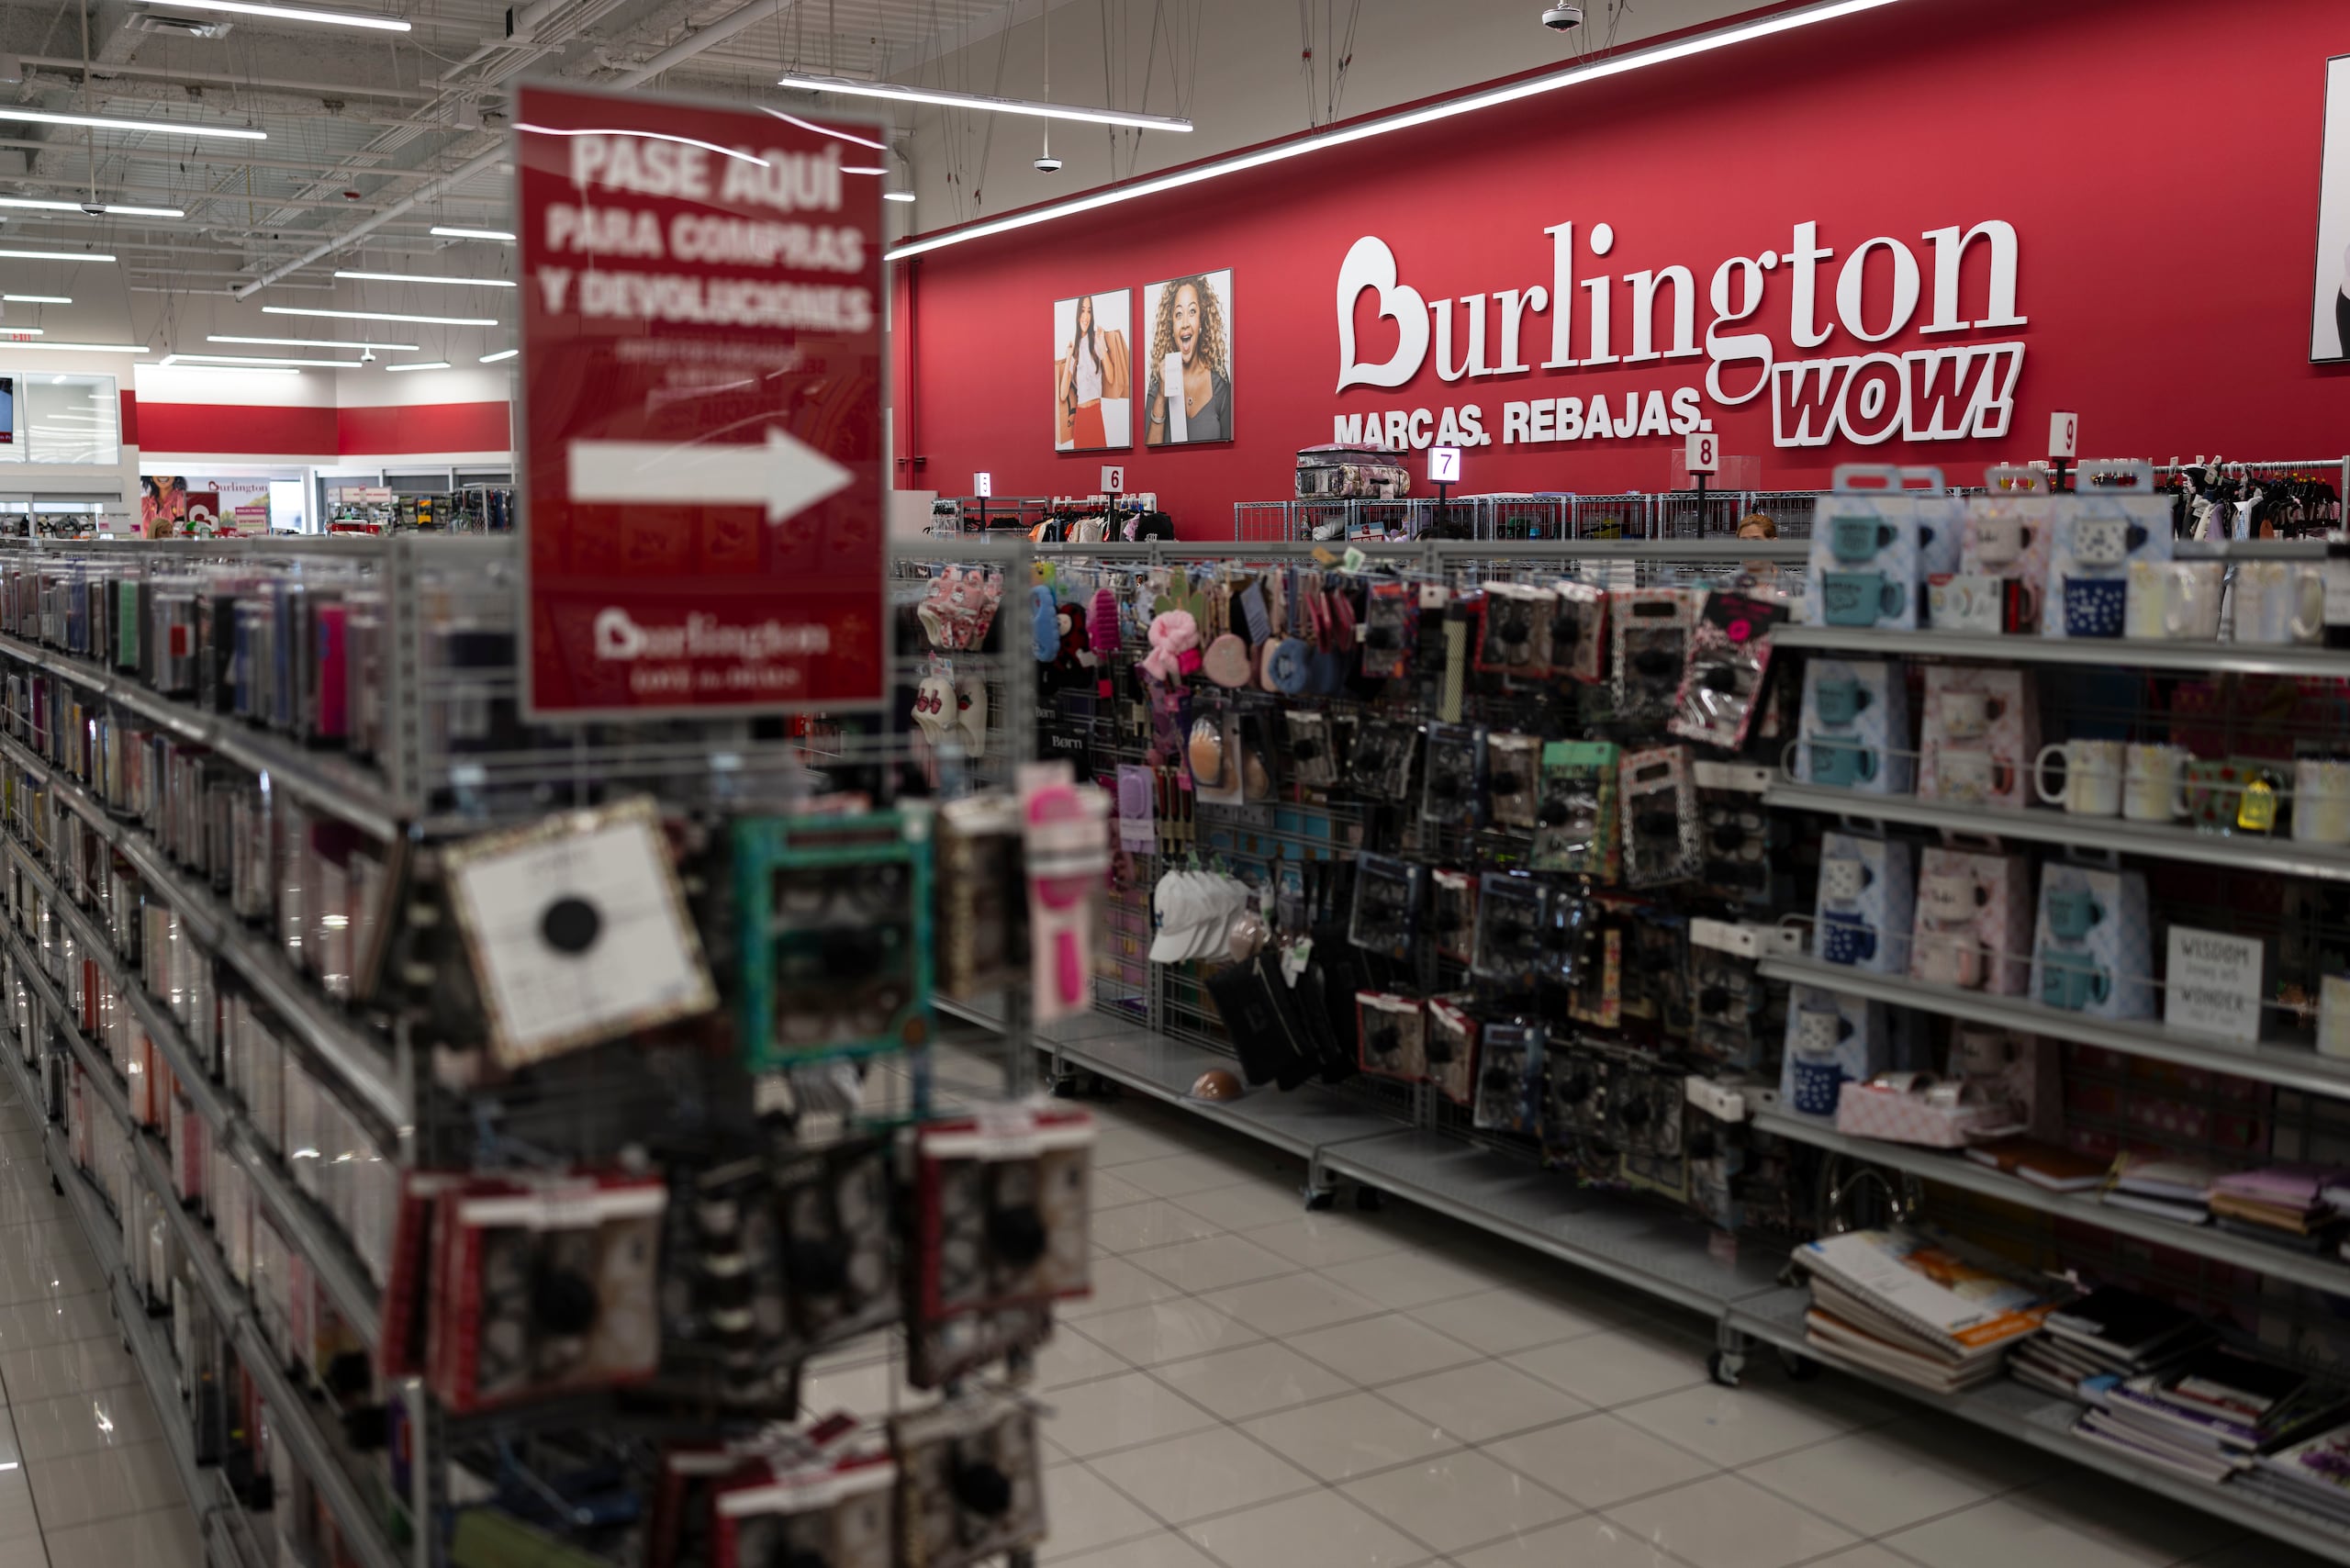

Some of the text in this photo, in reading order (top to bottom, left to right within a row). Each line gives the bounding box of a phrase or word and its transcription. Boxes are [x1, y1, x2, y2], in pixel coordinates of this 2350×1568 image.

[571, 133, 845, 212] PASE AQUÍ
[544, 203, 867, 273] PARA COMPRAS
[537, 263, 875, 333] Y DEVOLUCIONES
[1335, 219, 2029, 407] Burlington
[1334, 386, 1714, 449] MARCAS. REBAJAS.
[1772, 342, 2027, 448] WOW!
[1700, 439, 1713, 465] 8
[2066, 419, 2074, 450] 9
[208, 480, 269, 493] Burlington
[1111, 470, 1120, 488] 6
[1440, 454, 1453, 476] 7
[593, 606, 830, 661] Burlington
[2181, 936, 2250, 968] WISDOM
